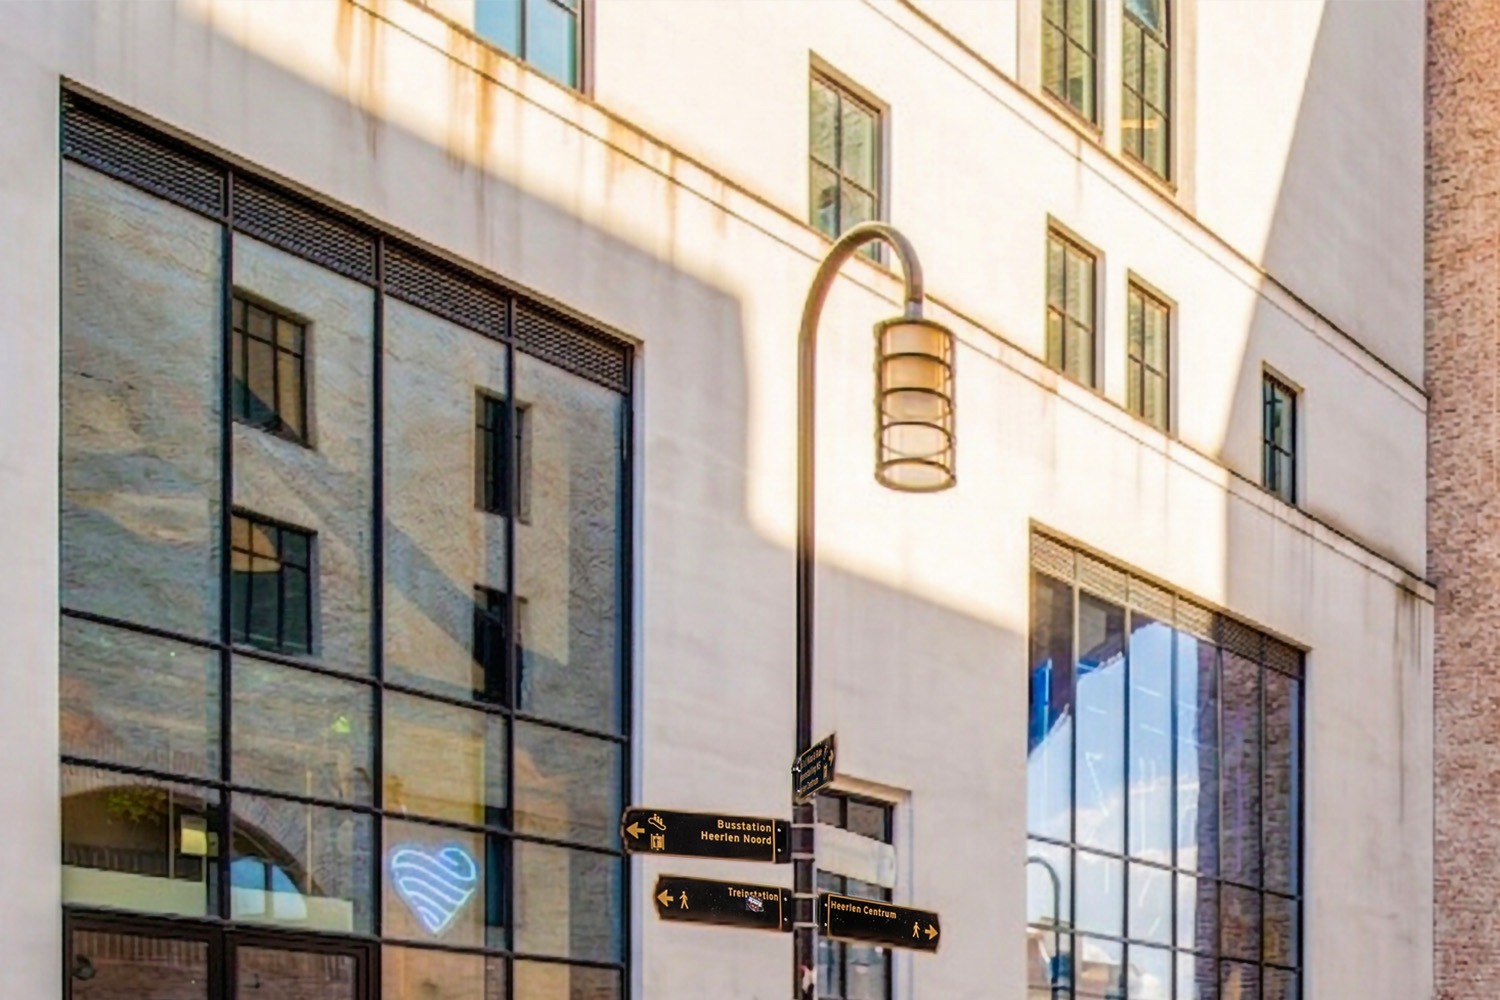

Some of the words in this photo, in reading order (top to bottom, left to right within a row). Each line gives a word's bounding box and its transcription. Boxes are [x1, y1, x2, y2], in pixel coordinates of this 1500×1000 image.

[717, 820, 772, 833] Busstation
[700, 831, 740, 842] Heerlen
[743, 834, 772, 845] Noord
[728, 887, 779, 902] Treinstation
[830, 900, 862, 914] Heerlen
[863, 905, 897, 919] Centrum
